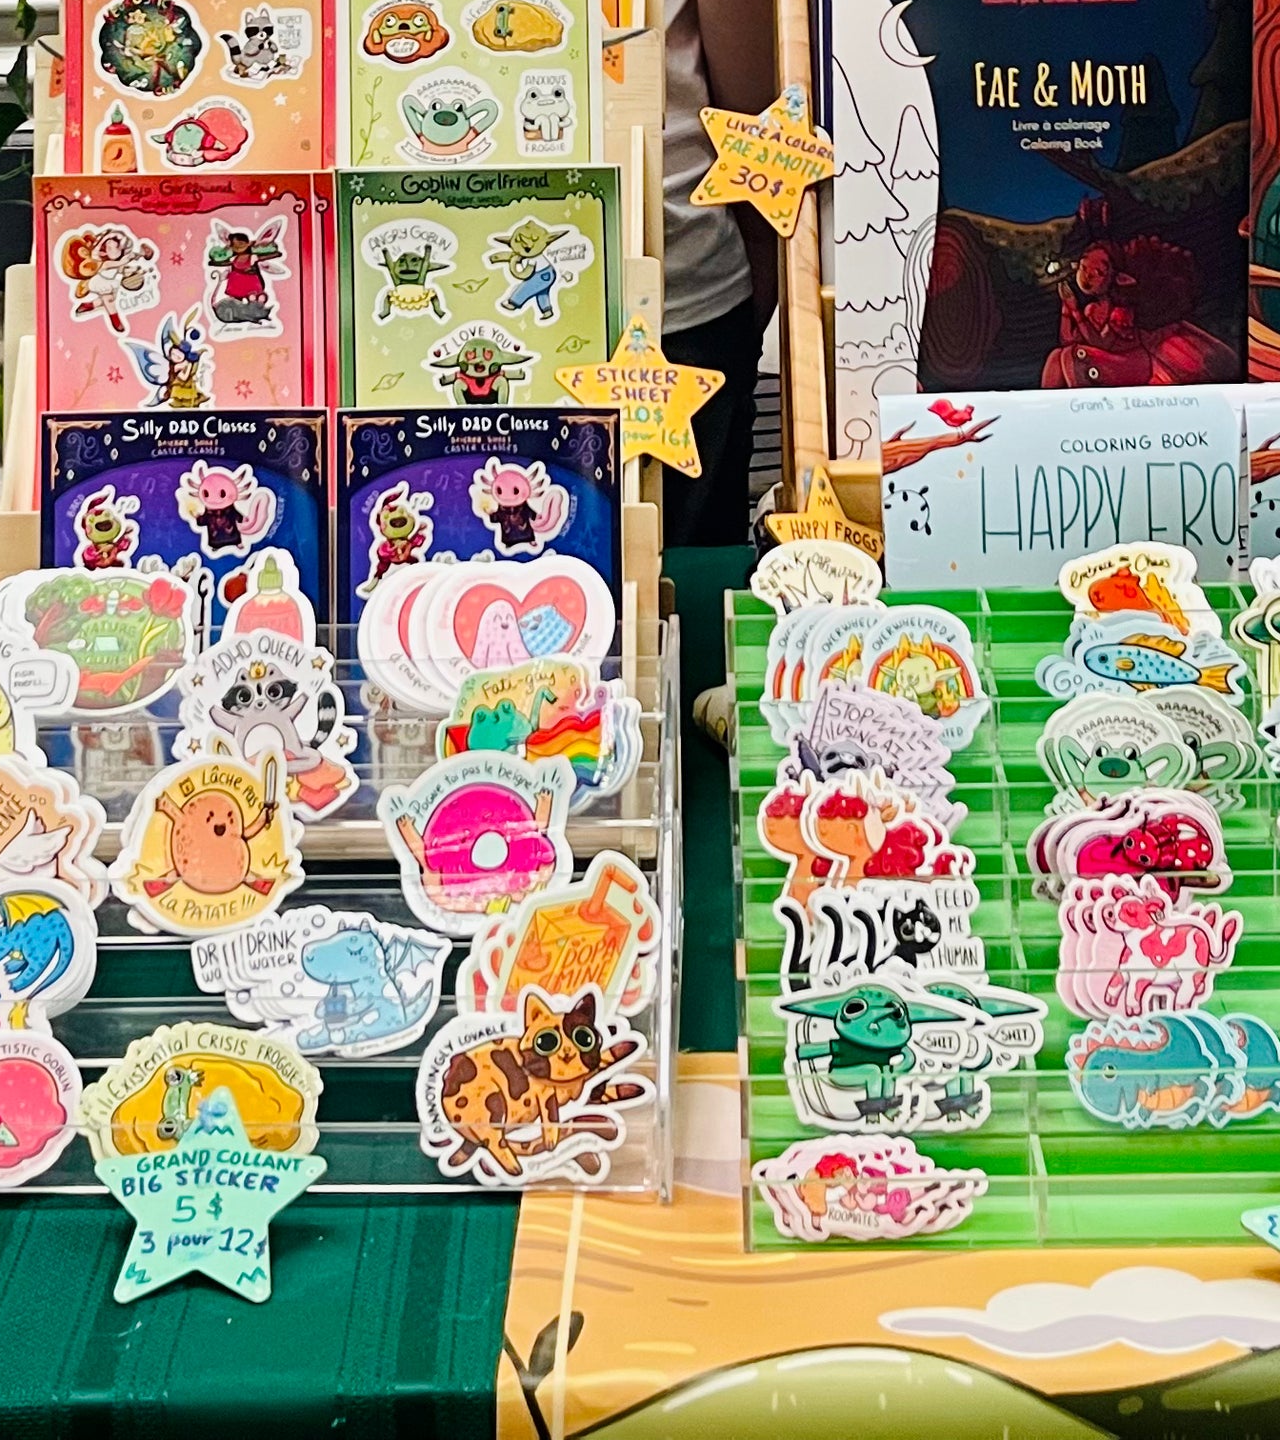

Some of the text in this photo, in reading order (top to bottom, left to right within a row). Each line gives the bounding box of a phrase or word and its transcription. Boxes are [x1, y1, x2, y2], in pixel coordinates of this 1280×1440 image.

[976, 61, 1146, 108] FAE & MOTH
[1021, 138, 1102, 151] Coloring Book
[466, 172, 549, 192] Girlfriend
[596, 368, 678, 385] STICKER
[612, 385, 671, 403] SHEET
[122, 415, 256, 439] Silly D&D Classes
[212, 636, 306, 681] ADHD QUEEN
[827, 697, 874, 723] STOP
[935, 887, 973, 909] FEED
[950, 918, 965, 933] ME
[937, 944, 979, 967] HUMAN
[458, 1021, 507, 1048] LOVABLE
[137, 1149, 305, 1172] GRAND COLLANT
[122, 1169, 279, 1196] BIG STICKER
[828, 1208, 880, 1228] ROOMATES
